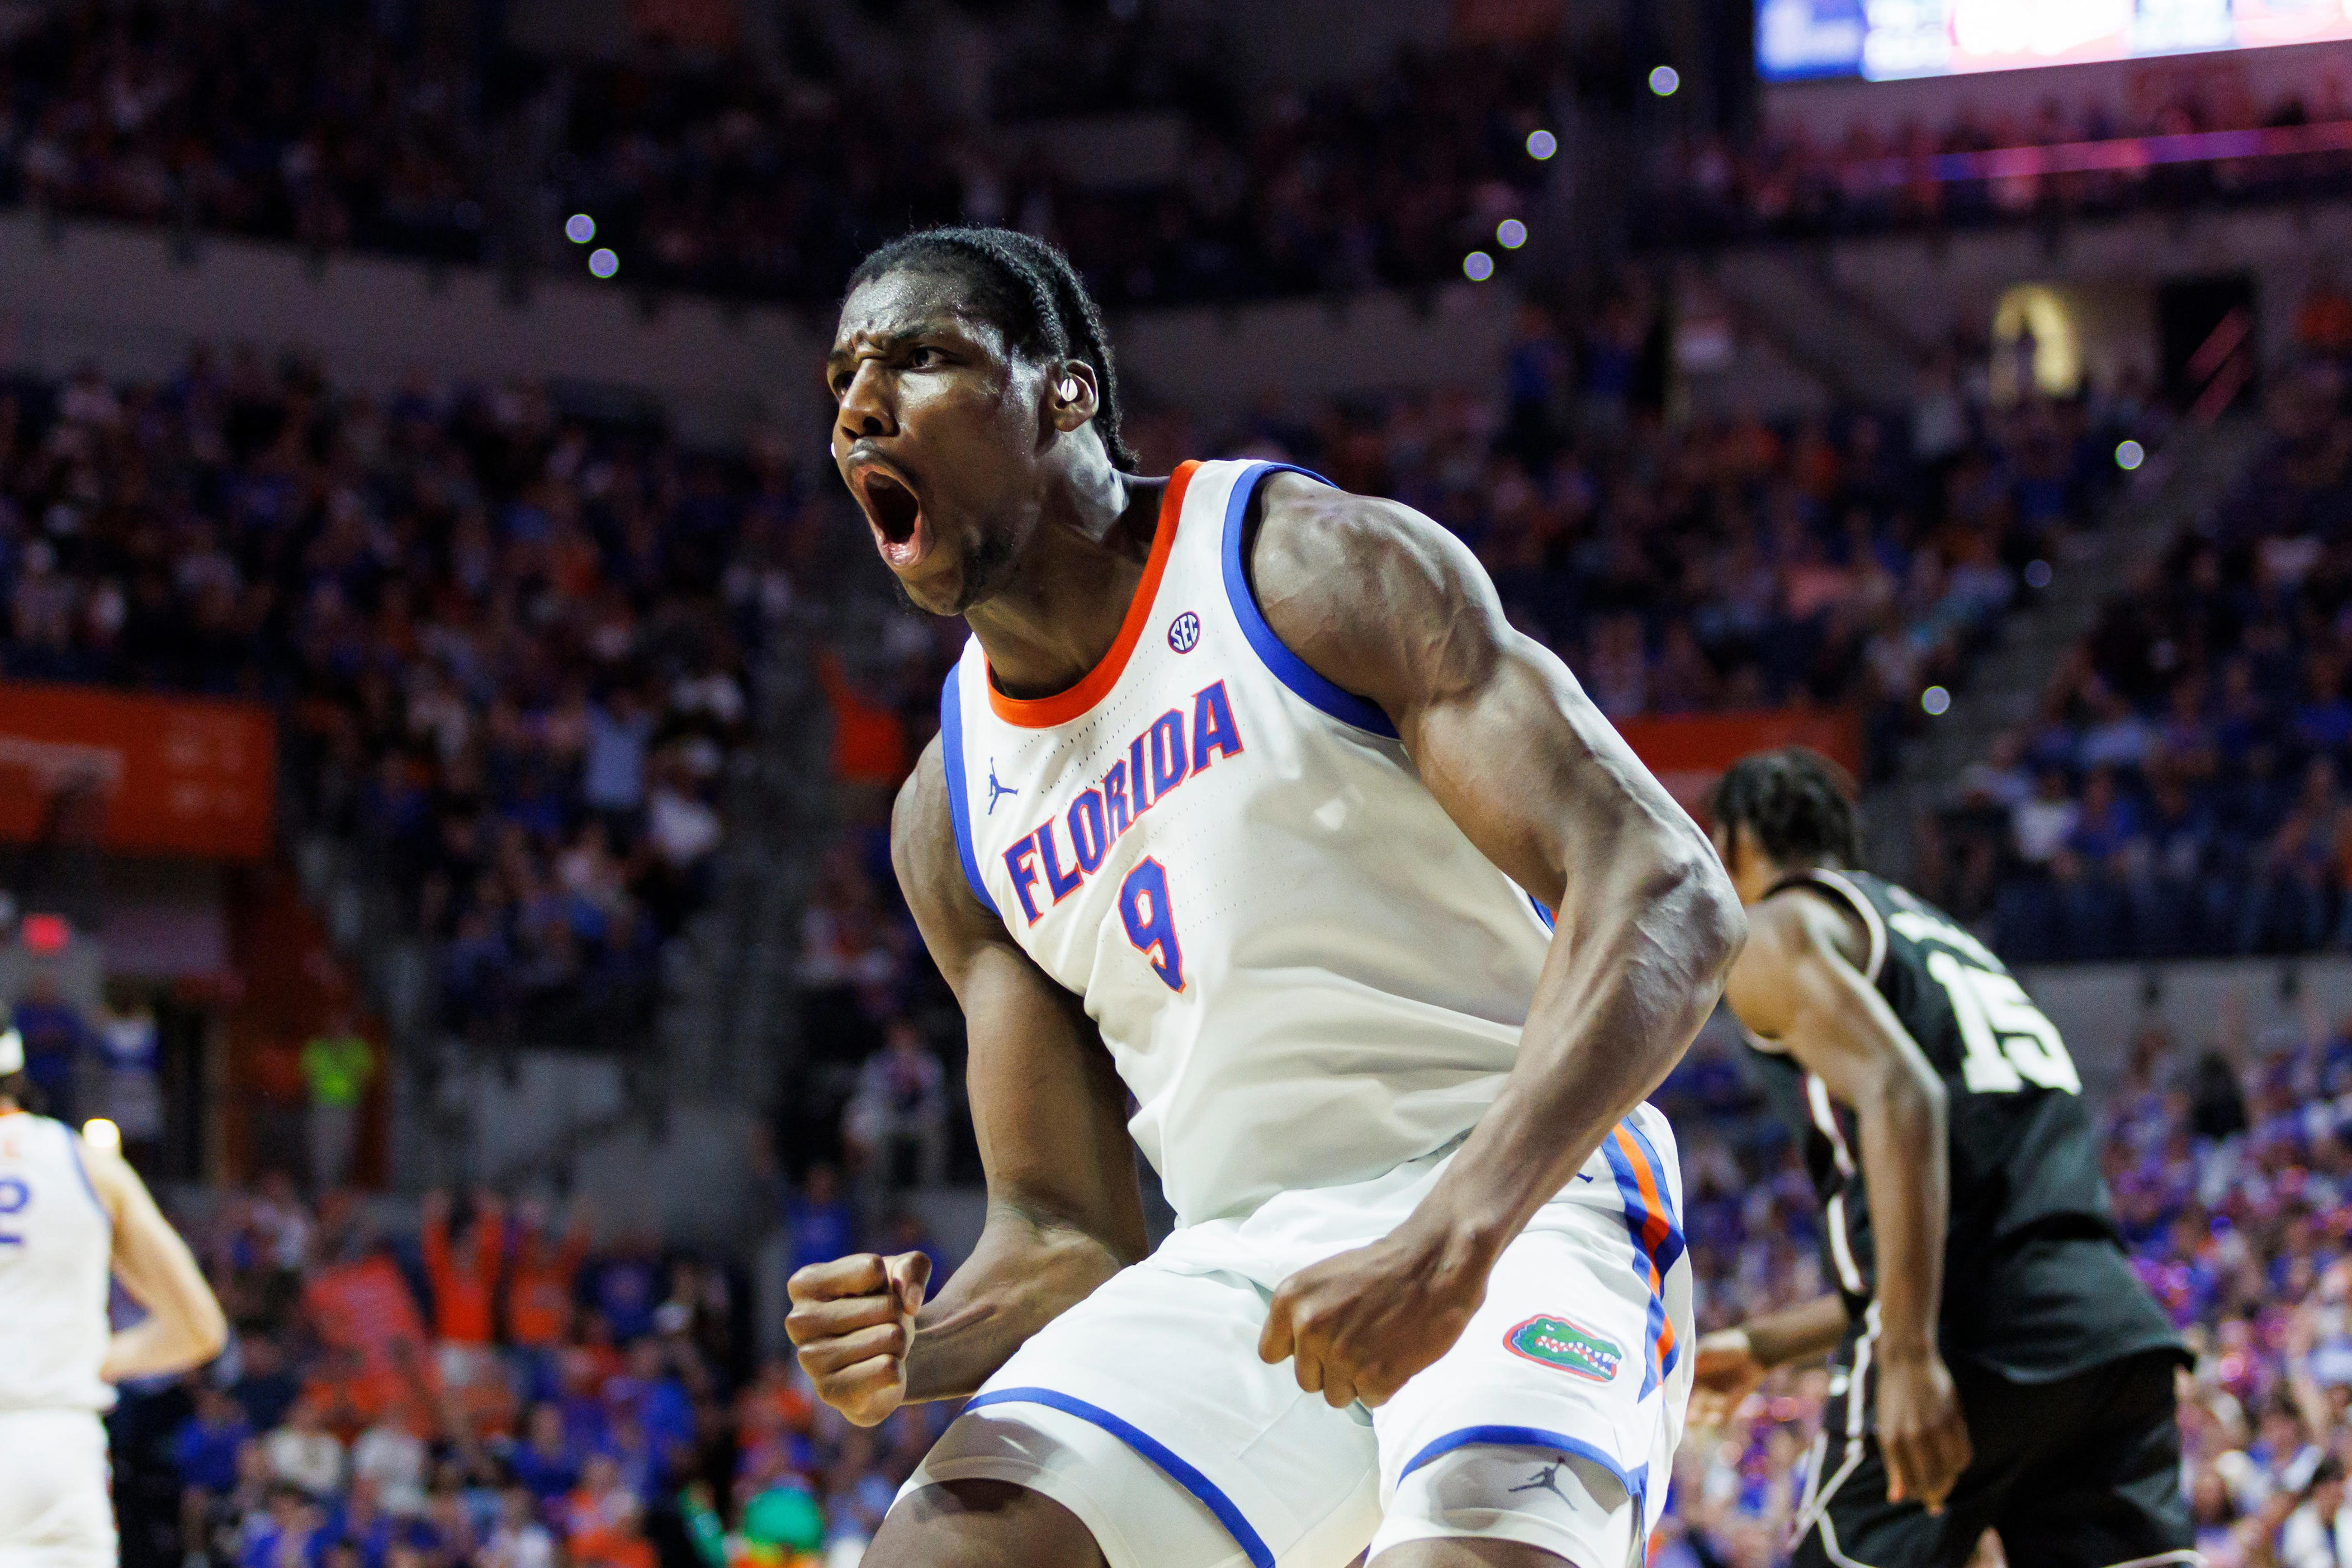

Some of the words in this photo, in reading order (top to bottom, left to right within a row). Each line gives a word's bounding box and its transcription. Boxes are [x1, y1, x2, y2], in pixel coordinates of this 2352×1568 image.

[1170, 614, 1199, 651] SEC
[1002, 679, 1244, 929] FLORIDA
[1118, 855, 1186, 994] 9
[1927, 950, 2083, 1096] 15
